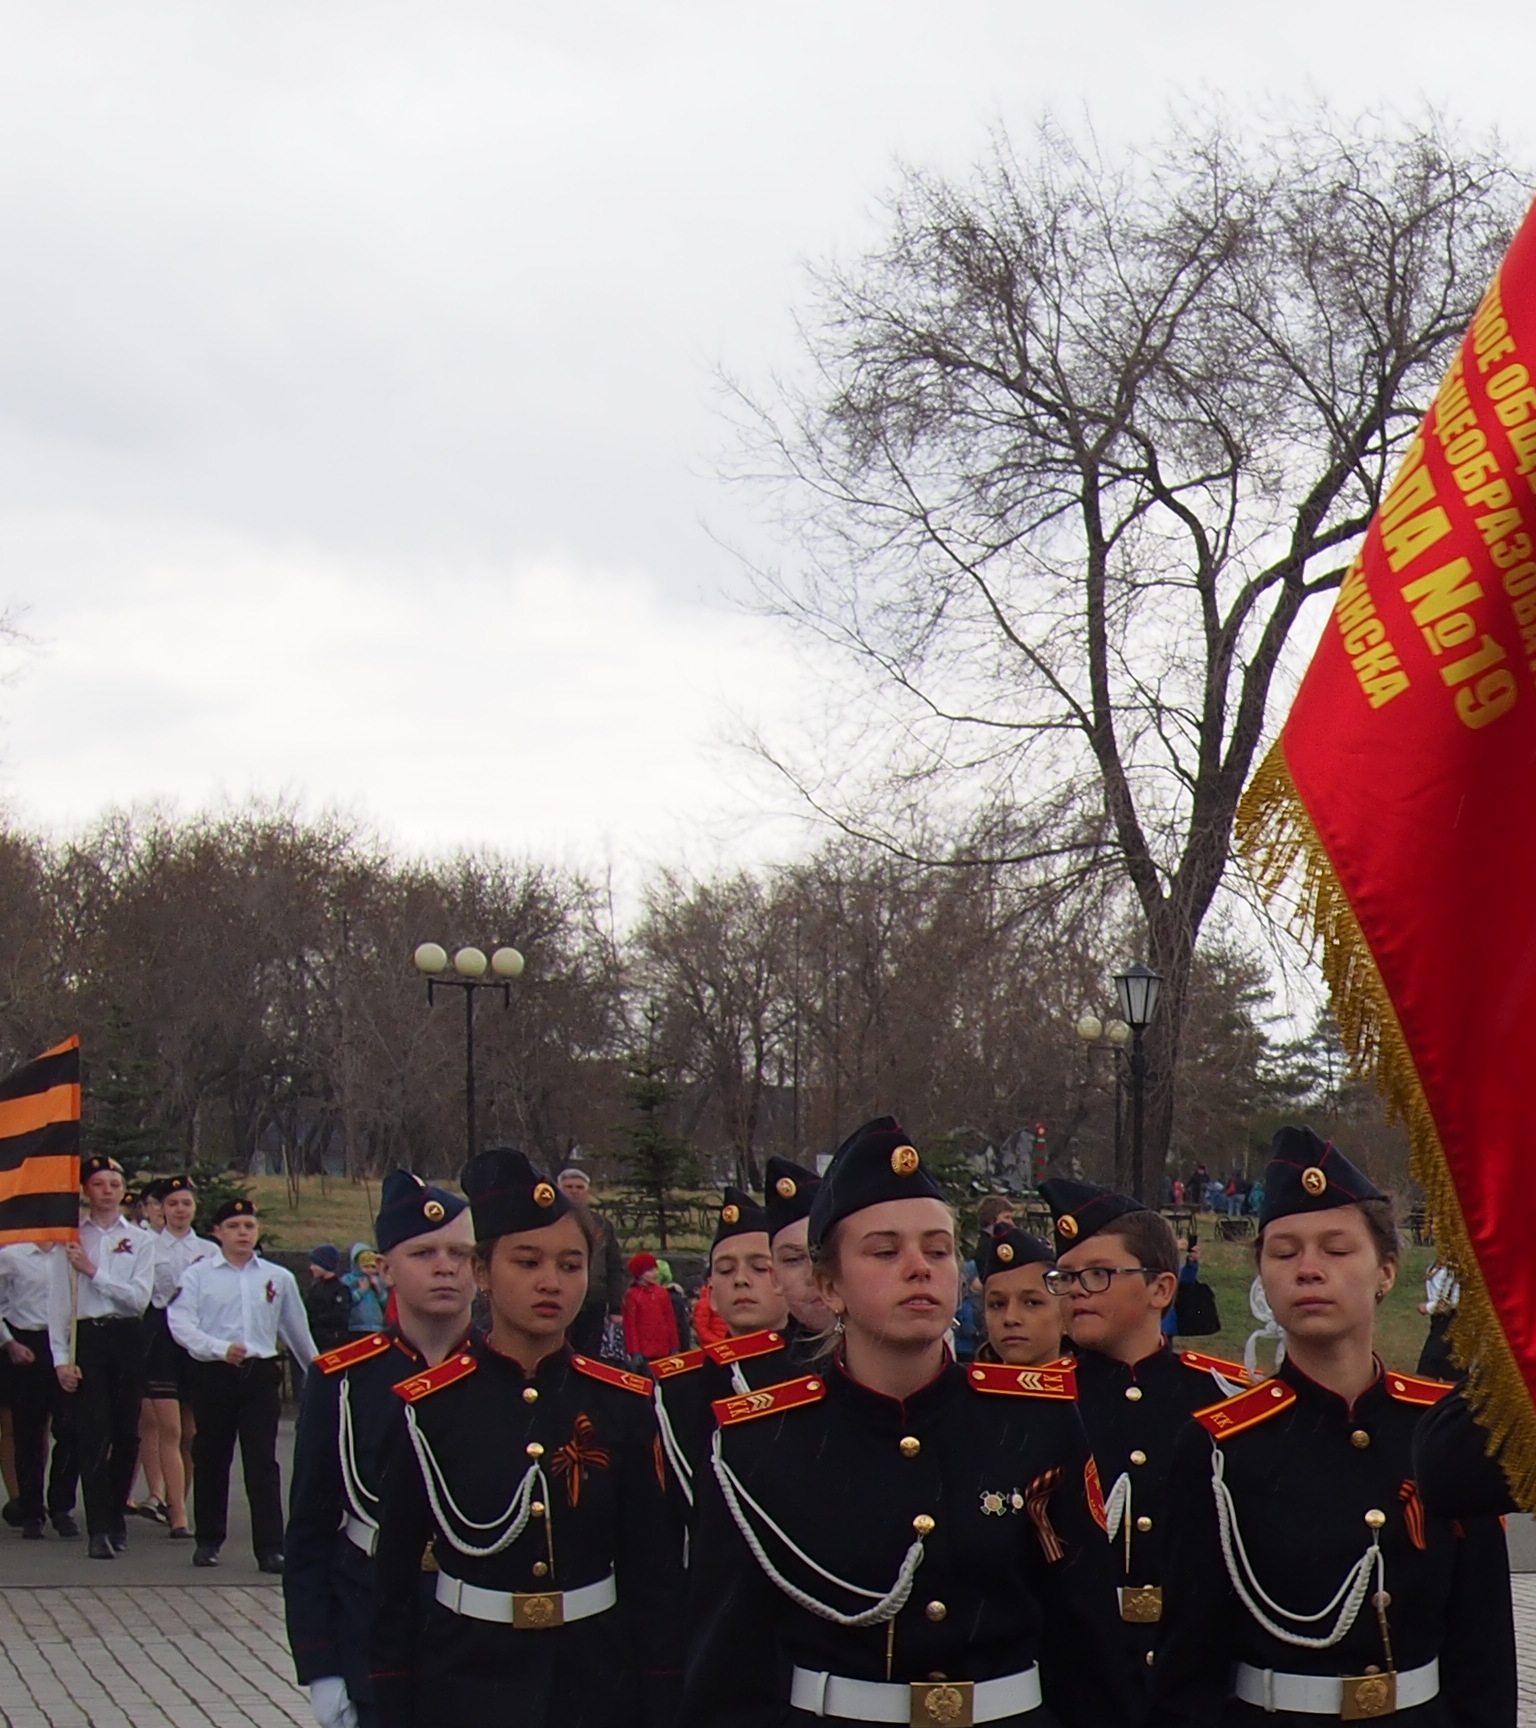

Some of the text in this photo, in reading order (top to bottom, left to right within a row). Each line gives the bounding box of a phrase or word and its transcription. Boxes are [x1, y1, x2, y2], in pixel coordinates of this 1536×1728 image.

[1377, 436, 1453, 574] ОЛА
[1334, 552, 1411, 710] ИНСКА
[1043, 1373, 1065, 1393] КК
